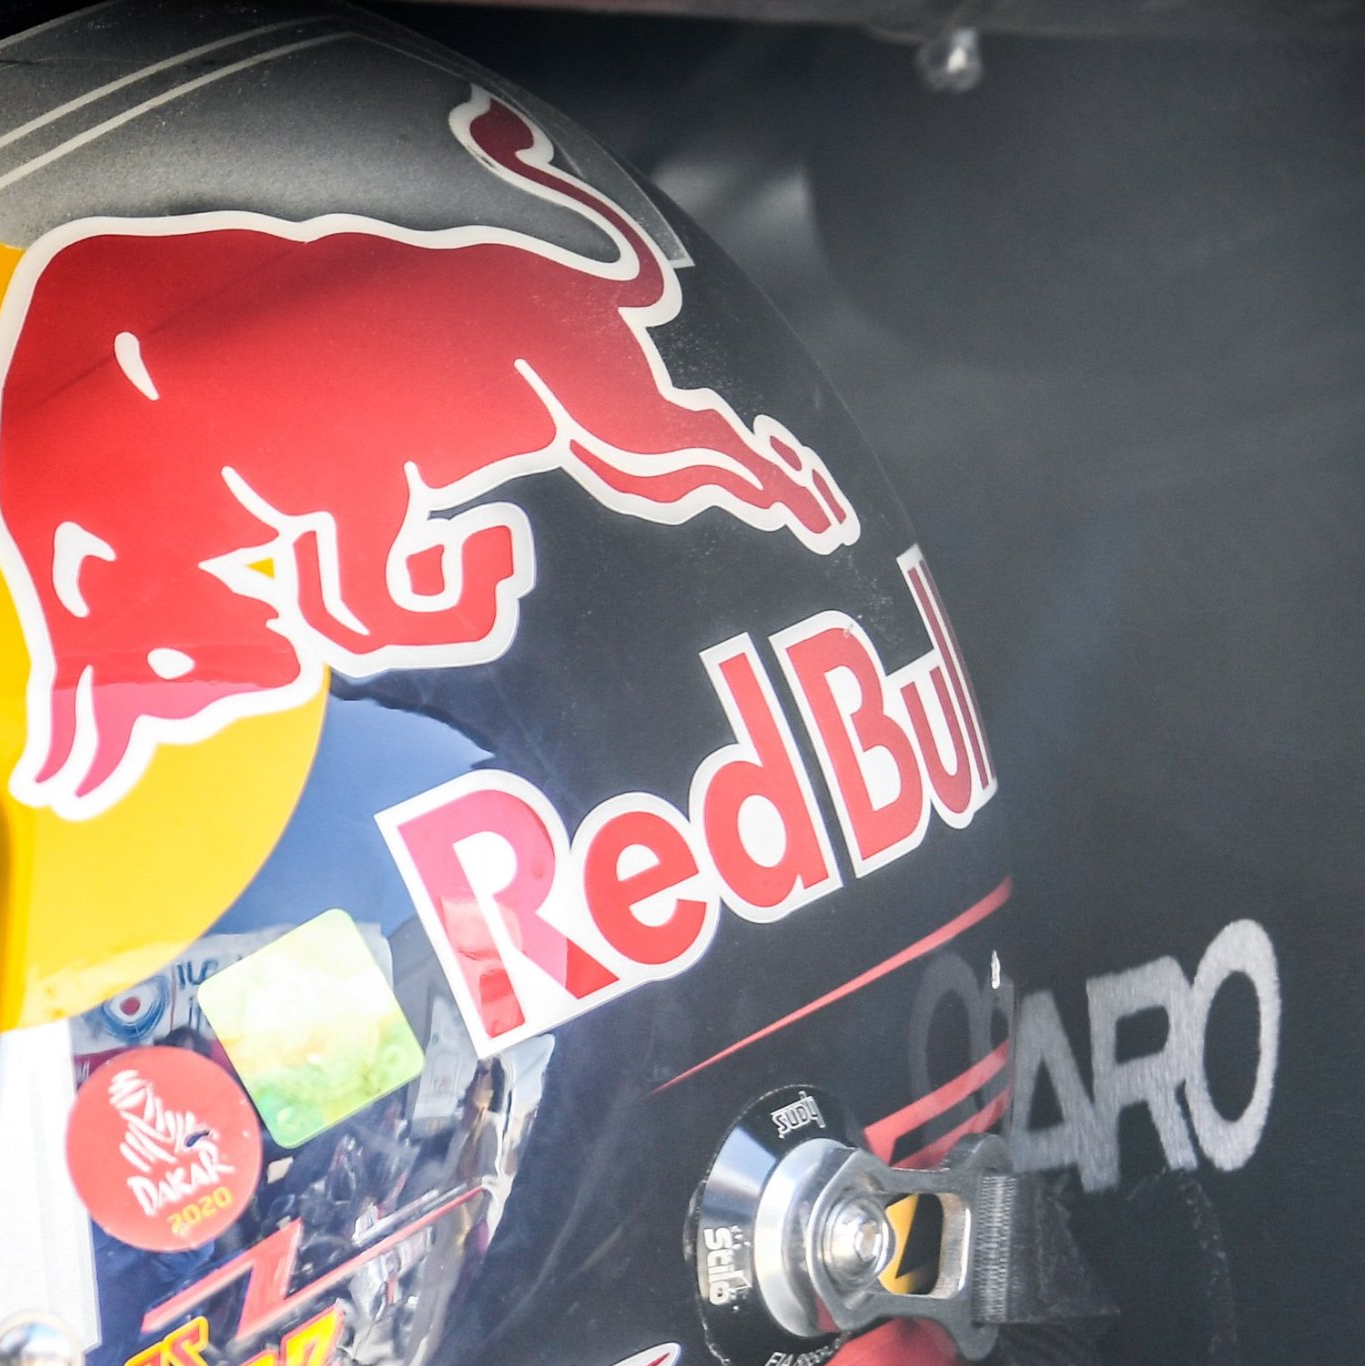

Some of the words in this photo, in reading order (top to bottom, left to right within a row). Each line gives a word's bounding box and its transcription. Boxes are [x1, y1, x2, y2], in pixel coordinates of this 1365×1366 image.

[375, 634, 841, 1060] Red
[771, 544, 997, 878] Bull
[127, 1148, 236, 1216] DAKAR
[168, 1186, 233, 1236] 2020
